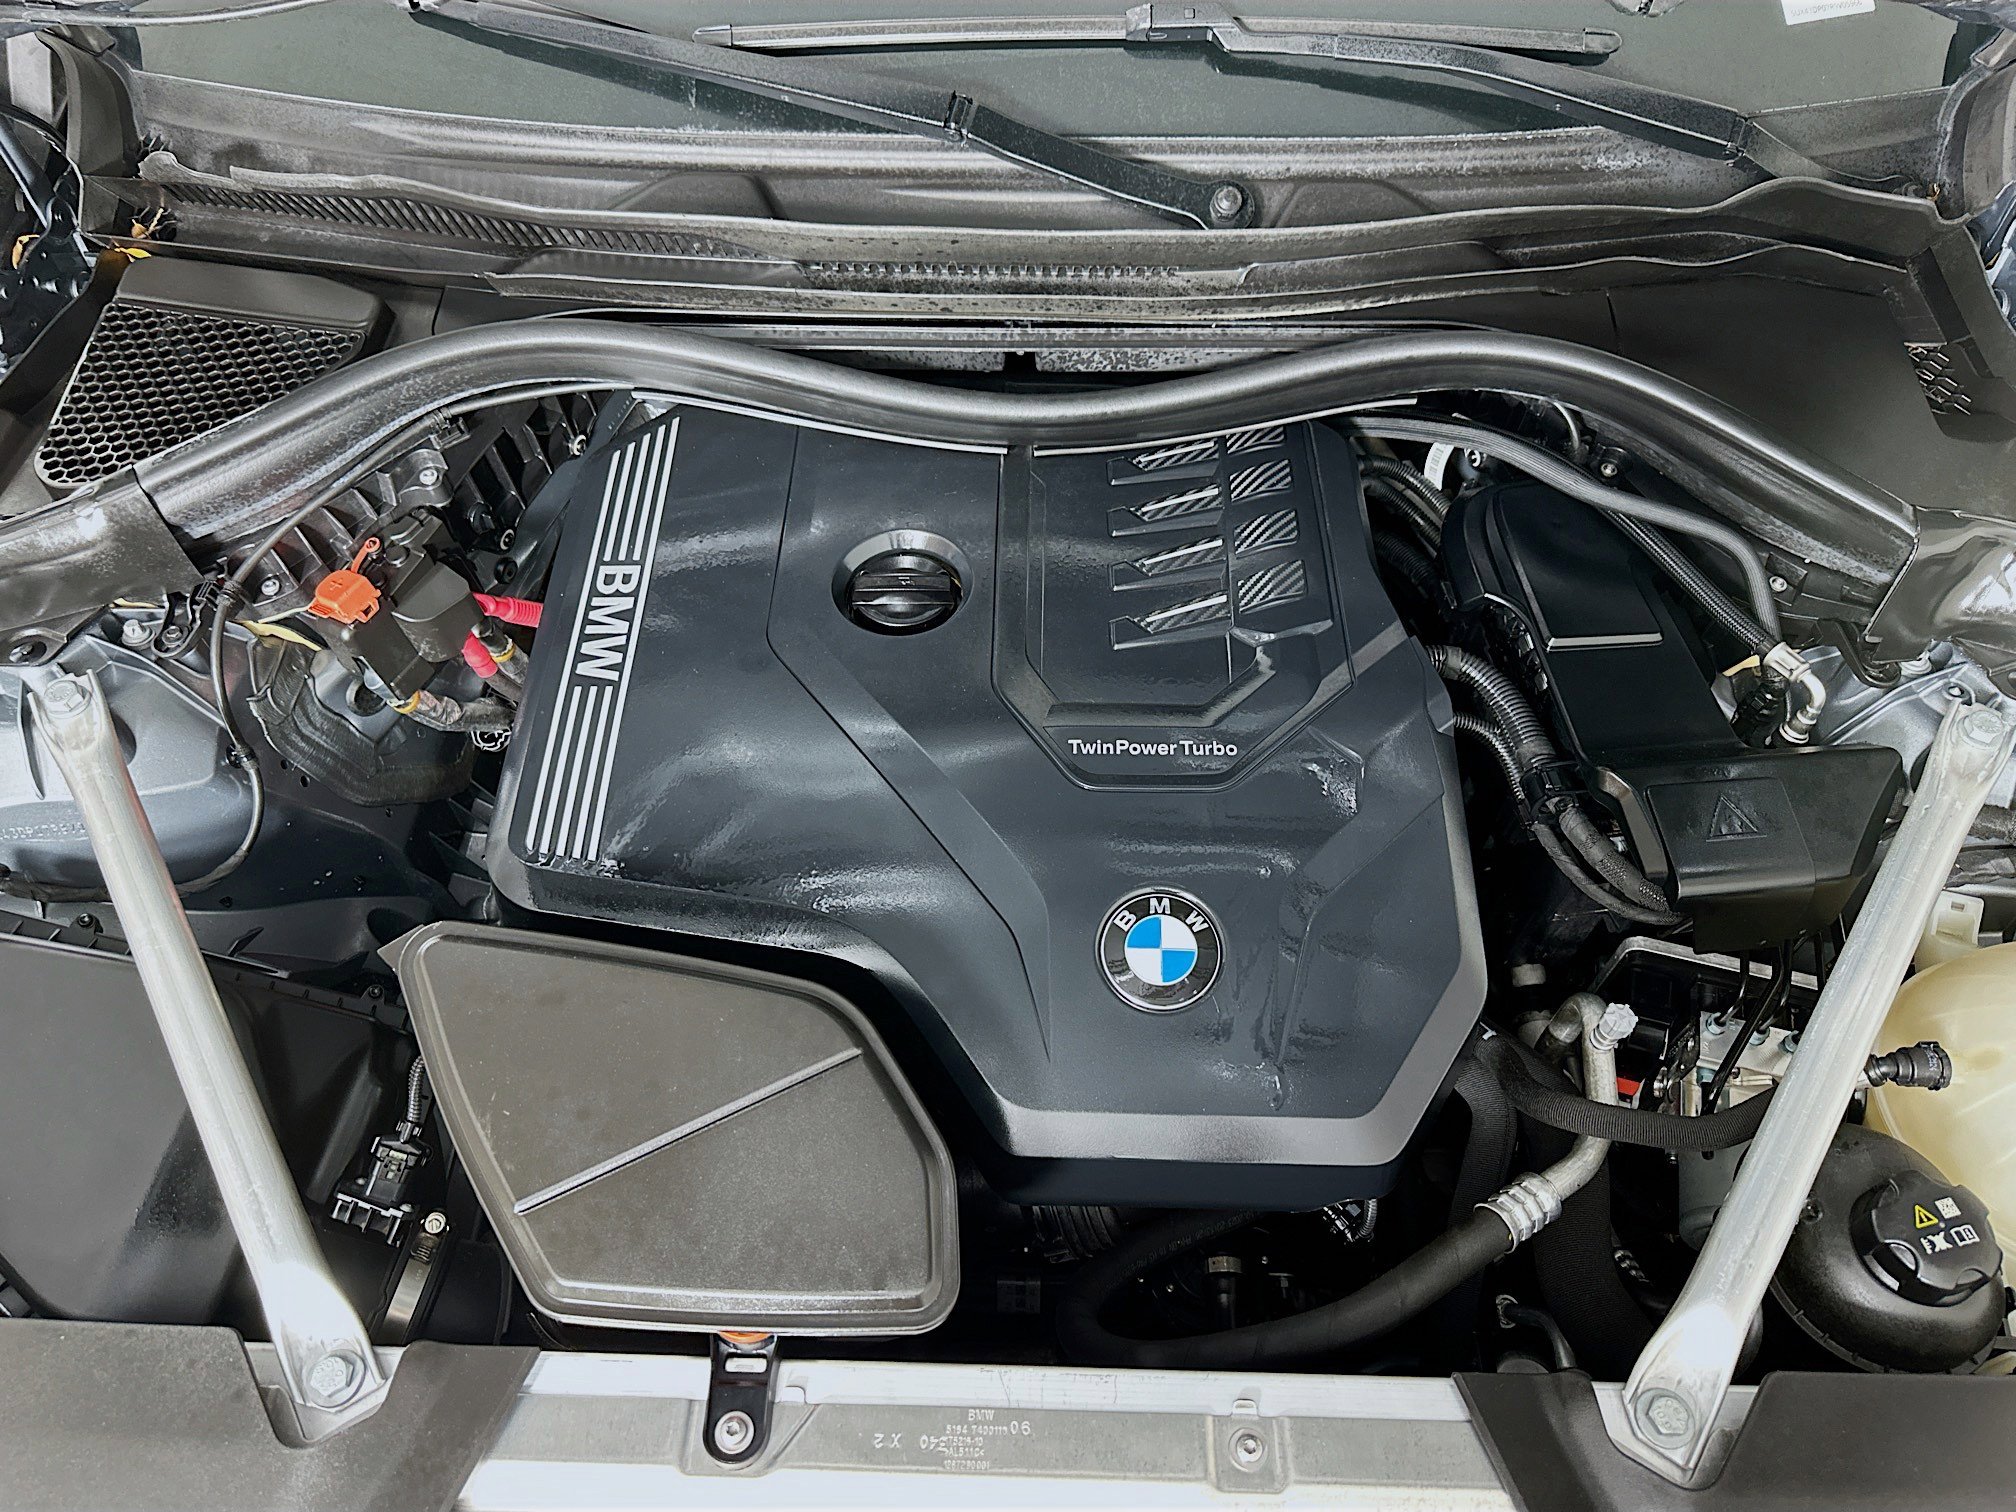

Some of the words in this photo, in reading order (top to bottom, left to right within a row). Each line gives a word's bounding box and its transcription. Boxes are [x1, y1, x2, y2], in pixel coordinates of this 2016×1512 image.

[575, 565, 642, 682] BMW
[1067, 739, 1178, 756] TwinPower
[1179, 740, 1238, 757] Turbo
[1112, 897, 1209, 933] BMW
[968, 1408, 995, 1421] BMW
